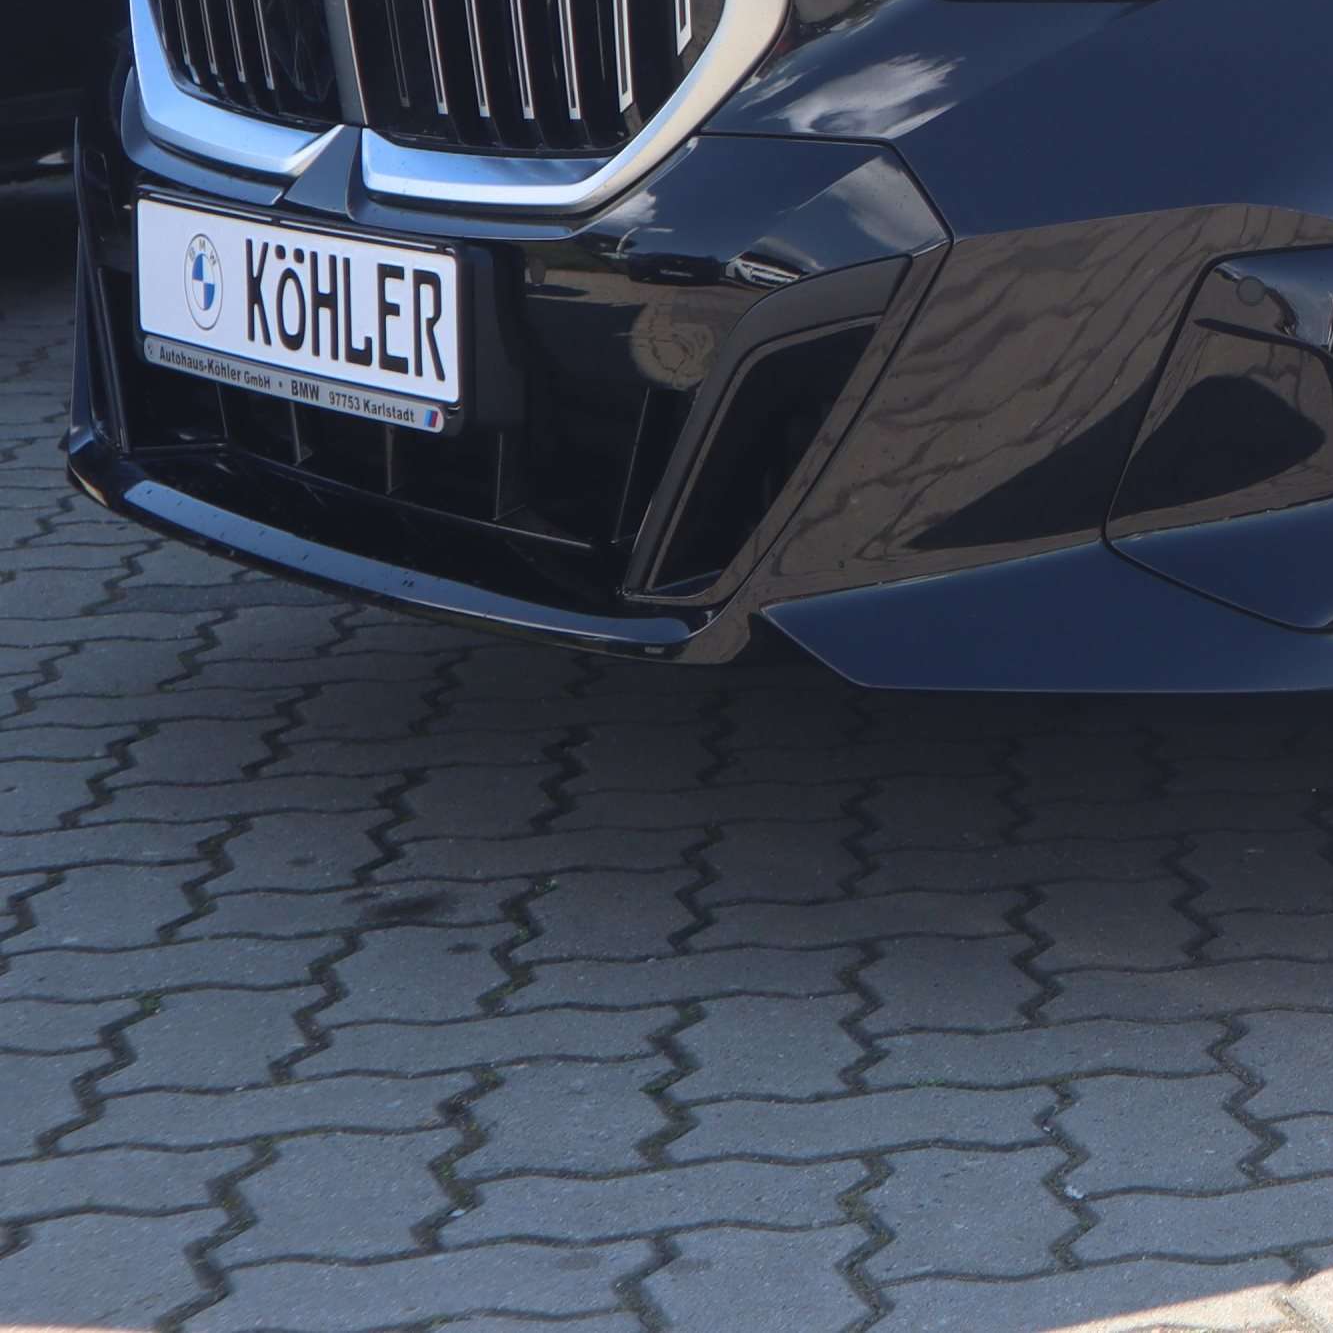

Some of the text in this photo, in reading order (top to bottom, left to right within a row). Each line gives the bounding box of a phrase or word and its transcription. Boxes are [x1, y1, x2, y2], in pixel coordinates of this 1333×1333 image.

[245, 237, 446, 383] KÖHLER
[159, 345, 416, 424] Autohaus-Köhler GmbH BMW 97753 Karlstadt
